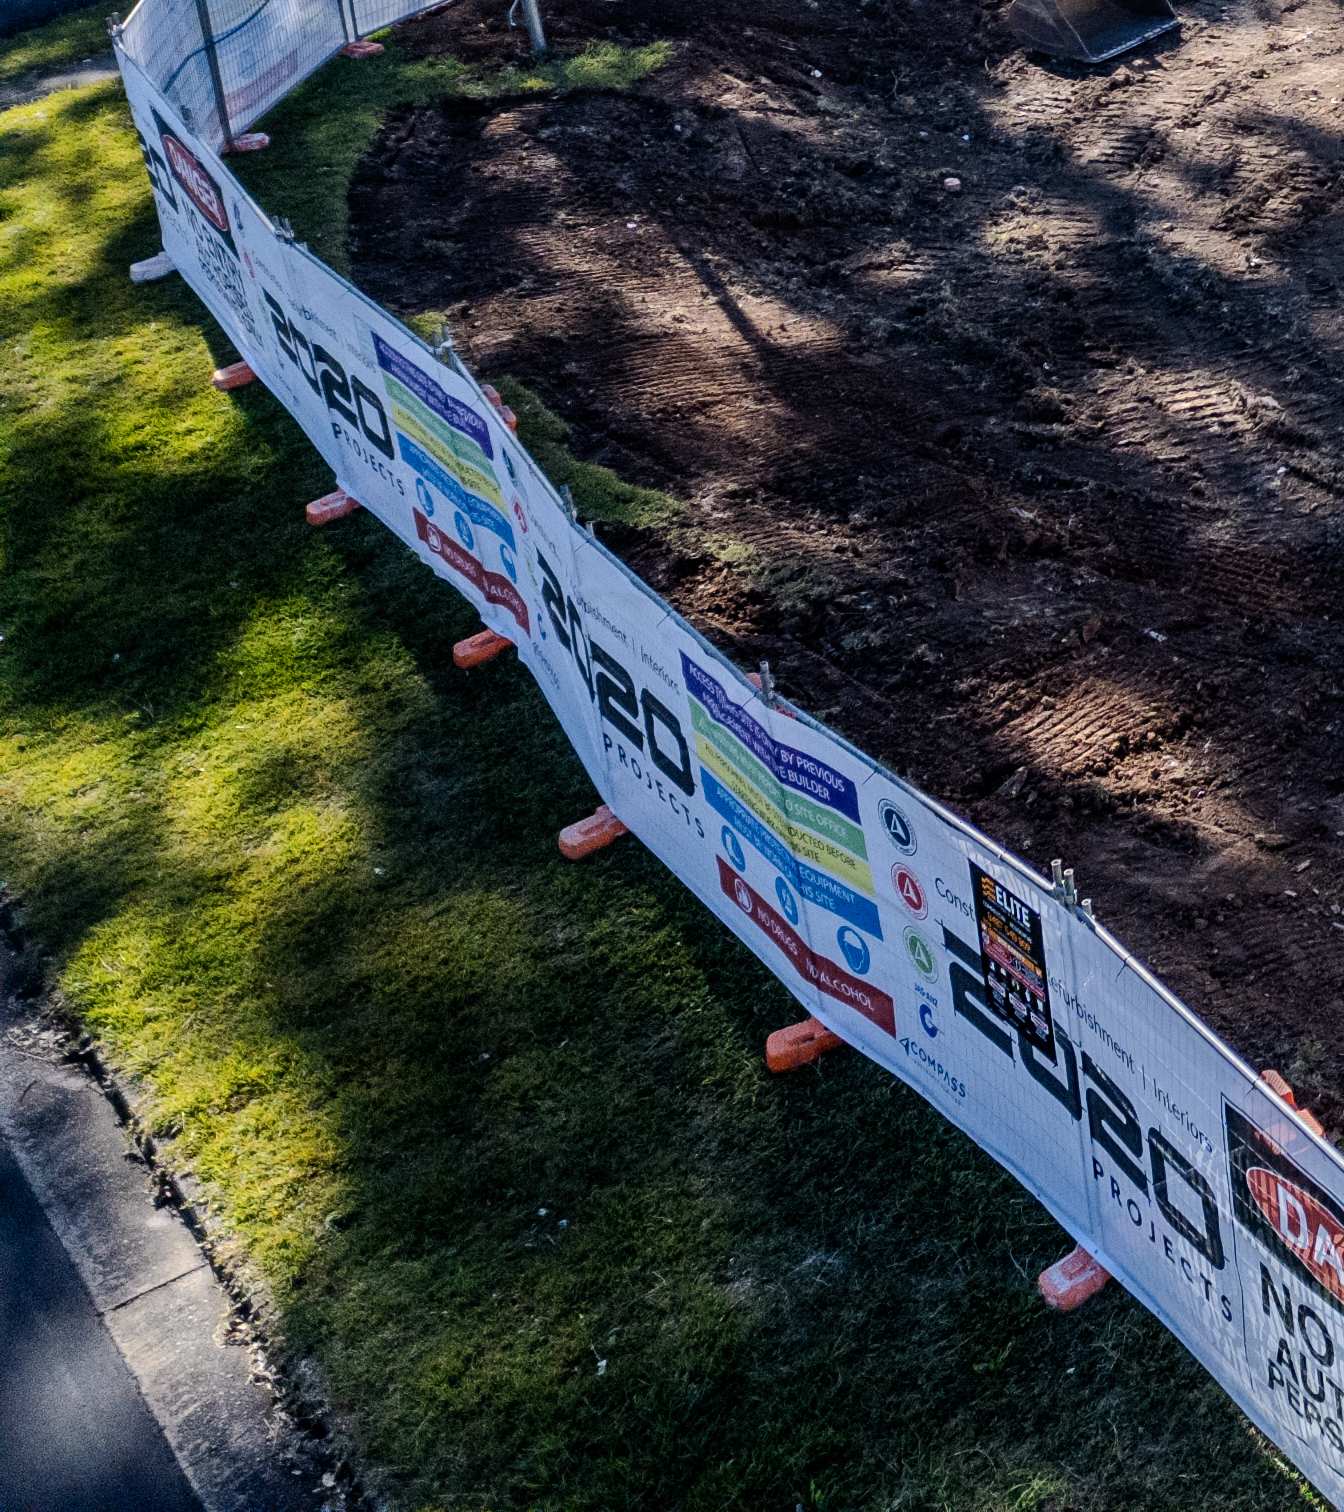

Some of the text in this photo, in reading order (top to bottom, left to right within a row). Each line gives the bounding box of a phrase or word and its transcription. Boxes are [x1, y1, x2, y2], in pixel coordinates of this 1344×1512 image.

[262, 284, 395, 461] 2020
[331, 422, 406, 497] PROJECTS
[536, 546, 696, 798] 2020
[602, 731, 705, 839] PROJECTS
[781, 749, 795, 765] BY
[796, 757, 845, 793] PREVIOUS
[788, 771, 831, 801] BUILDER
[795, 803, 816, 822] SITE
[816, 812, 847, 839] OFFICE
[803, 846, 820, 863] SITE
[825, 844, 857, 871] BEFORE
[800, 866, 855, 904] EQUIPMENT
[815, 890, 836, 909] SITE
[995, 885, 1031, 928] ELITE
[757, 906, 770, 927] NO
[770, 918, 798, 956] DRUGS
[819, 971, 875, 1012] ALCOHOL
[911, 1041, 966, 1098] COMPASS
[1050, 975, 1135, 1075] efurbishment
[1153, 1078, 1213, 1154] Interiors
[1092, 1156, 1233, 1322] PROJECTS
[1260, 1262, 1336, 1368] NO
